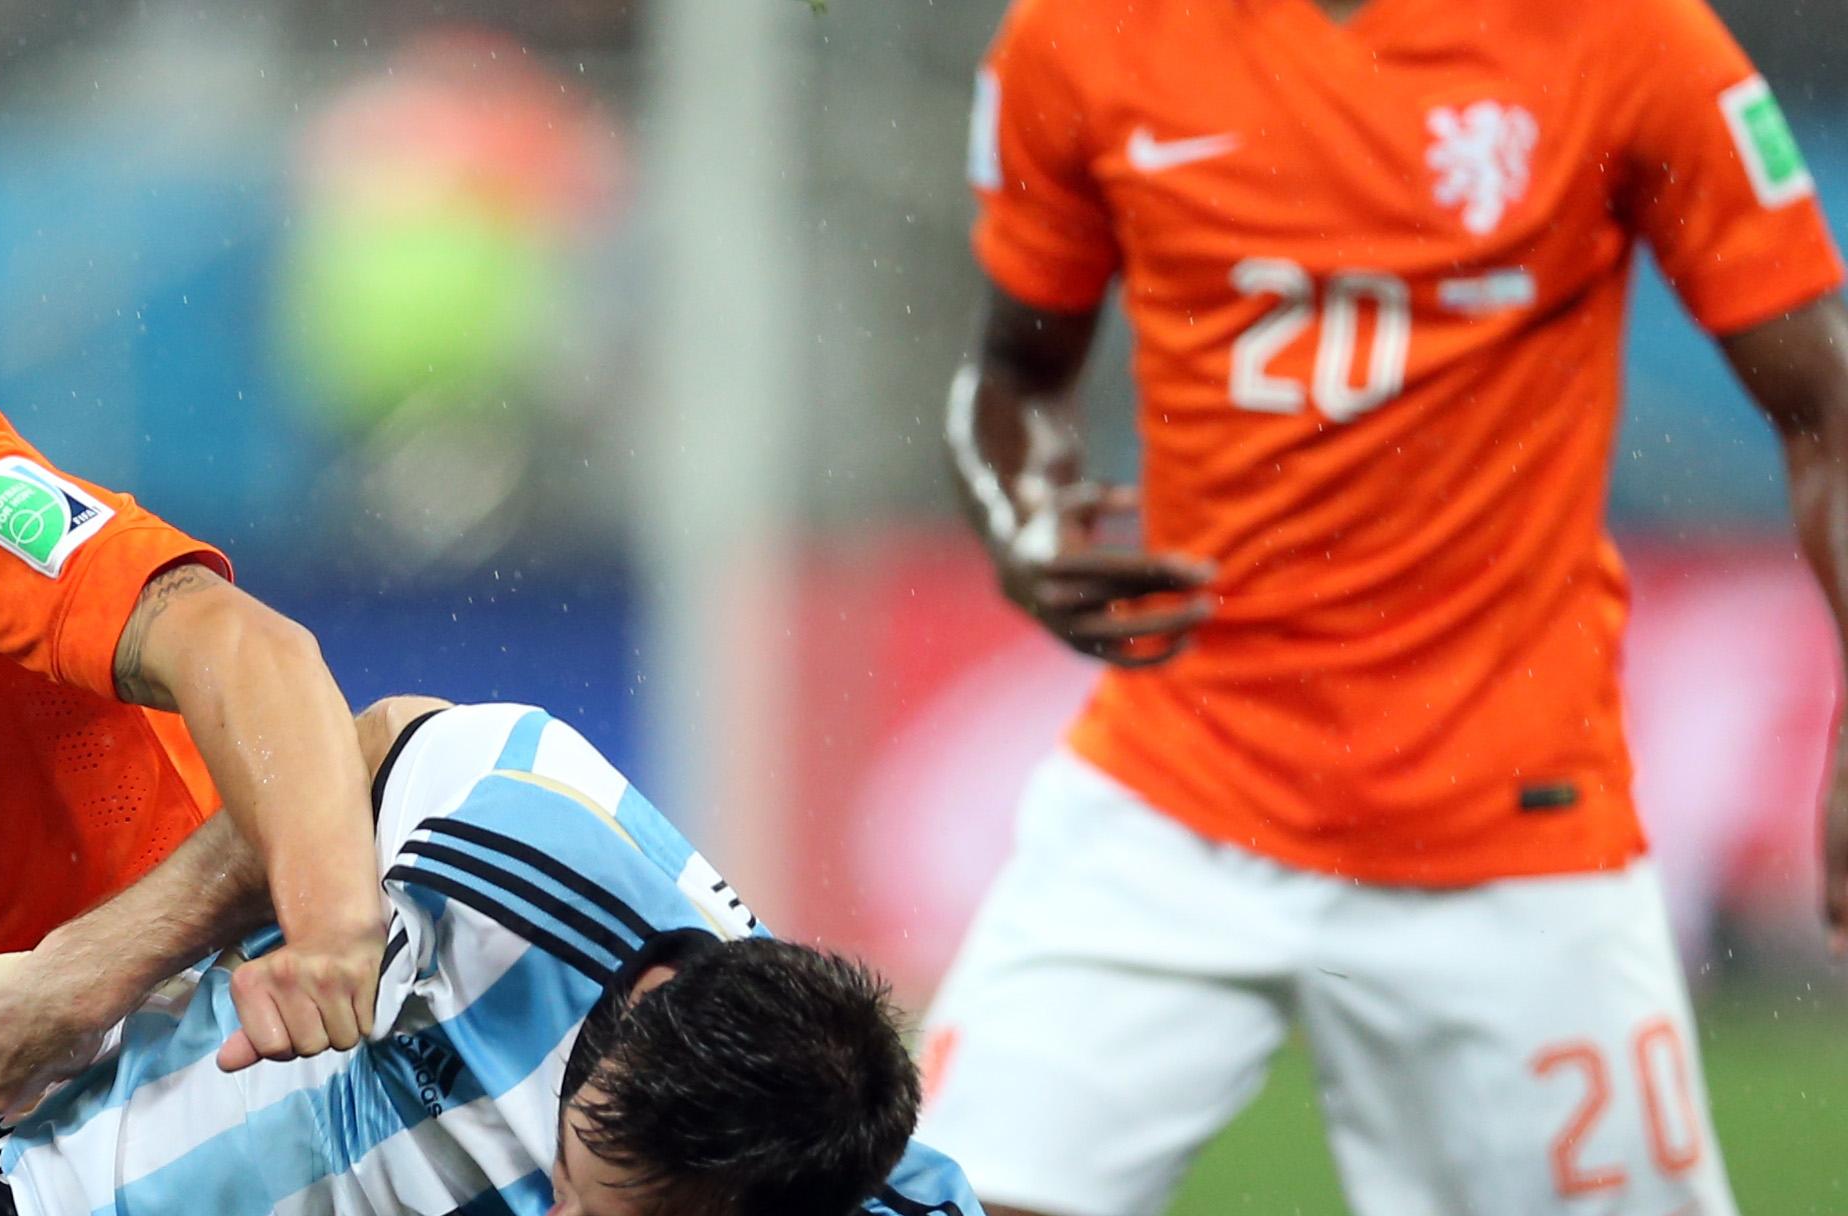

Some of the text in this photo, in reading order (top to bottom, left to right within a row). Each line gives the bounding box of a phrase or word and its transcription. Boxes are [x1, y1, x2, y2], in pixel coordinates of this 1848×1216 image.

[1229, 255, 1410, 423] 20
[72, 508, 98, 526] FIFA
[1528, 1014, 1703, 1200] 20
